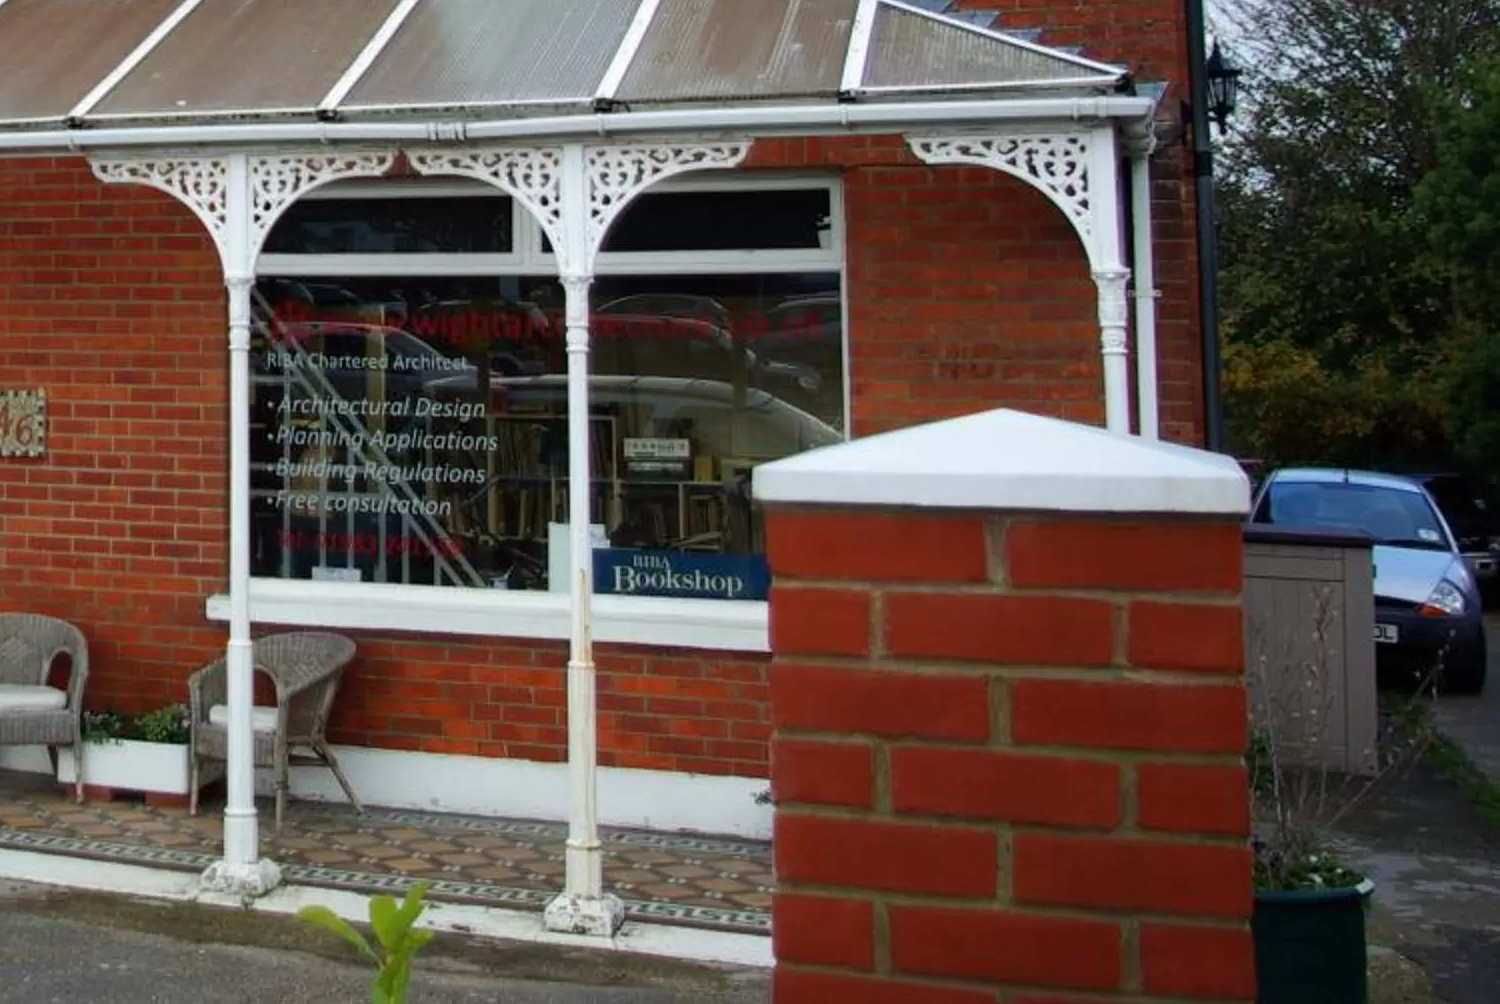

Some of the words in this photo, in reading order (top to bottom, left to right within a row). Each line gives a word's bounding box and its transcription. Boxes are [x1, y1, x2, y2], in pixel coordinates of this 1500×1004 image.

[267, 352, 304, 369] RIBA
[308, 350, 389, 370] Chartered
[392, 353, 470, 371] Architect
[276, 395, 410, 417] Architectural
[414, 398, 486, 422] Design
[275, 425, 363, 450] Planning
[369, 428, 500, 453] Applications
[274, 456, 363, 482] Building
[363, 460, 487, 485] Regulations
[275, 489, 319, 510] Free
[324, 493, 451, 517] consultation
[612, 564, 744, 597] Bookshop
